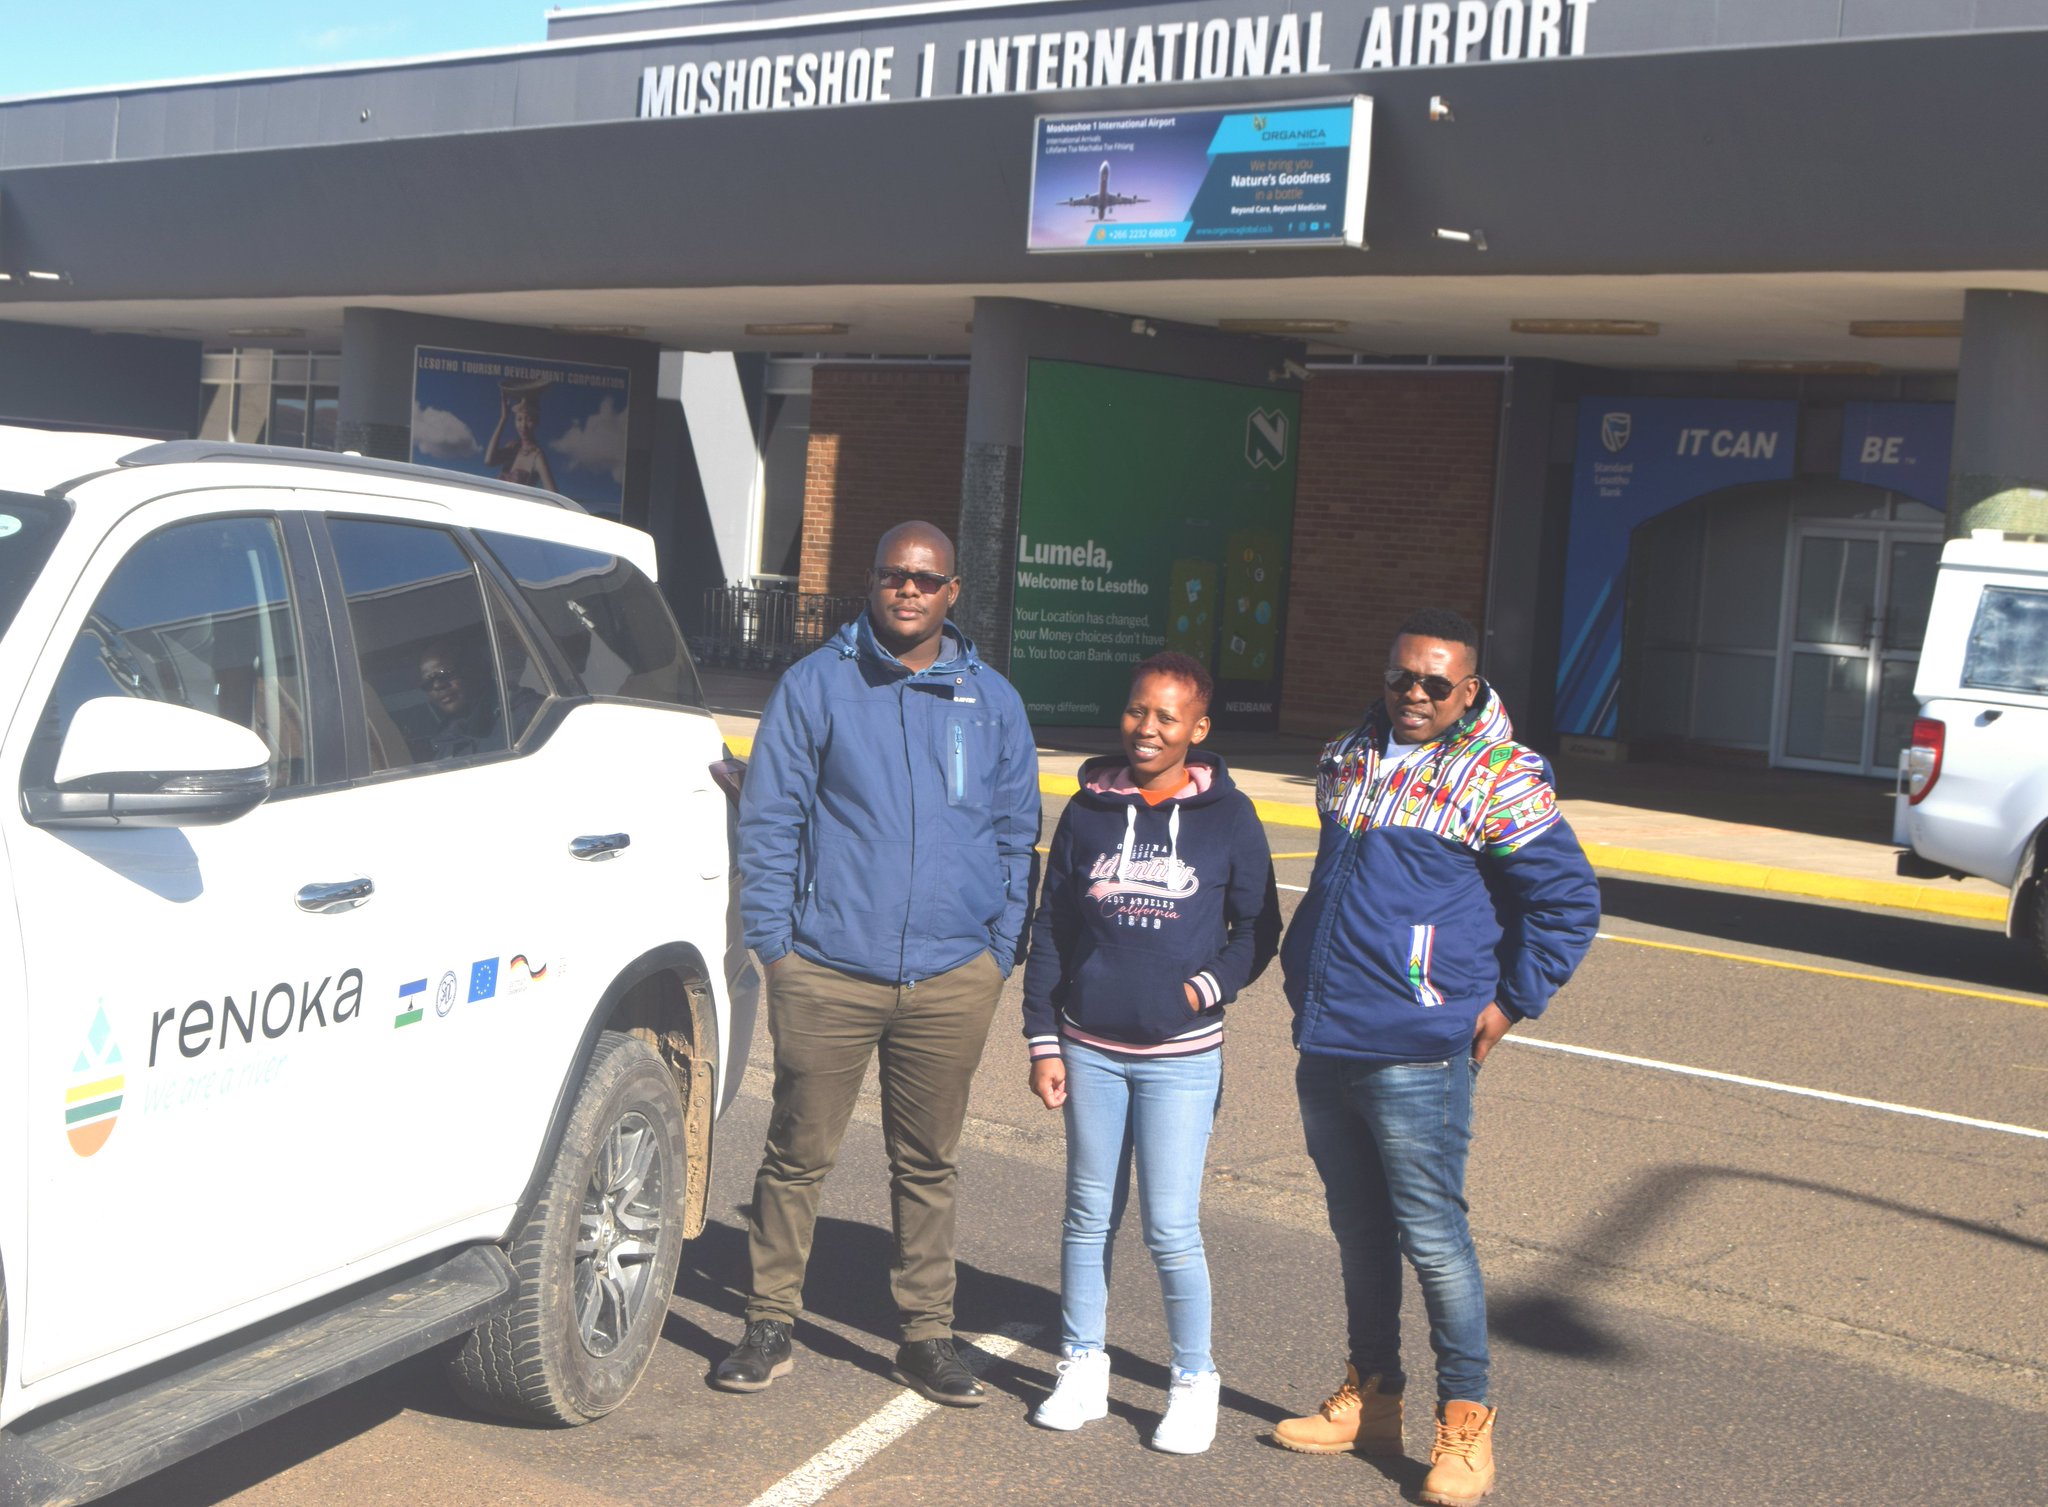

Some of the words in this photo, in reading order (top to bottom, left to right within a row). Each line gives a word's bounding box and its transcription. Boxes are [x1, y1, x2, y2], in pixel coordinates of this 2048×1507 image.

[640, 46, 894, 119] MOSHOESHOE
[920, 43, 935, 98] I
[961, 12, 1331, 96] INTERNATIONAL
[1360, 0, 1597, 70] AIRPORT
[1046, 122, 1091, 133] Moshoeshoe
[1098, 119, 1147, 130] International
[1148, 117, 1176, 129] Airport
[1262, 129, 1326, 141] ORGANICA
[1250, 160, 1265, 171] We
[1268, 159, 1293, 172] bring
[1296, 160, 1313, 171] you
[1231, 174, 1276, 187] Nature's
[1279, 172, 1331, 185] Goodness
[1255, 189, 1264, 200] in
[1266, 191, 1273, 200] a
[1275, 187, 1303, 200] bottle
[1231, 206, 1254, 215] Beyond
[1273, 204, 1296, 213] Beyond
[1297, 203, 1327, 212] Medicine
[418, 356, 458, 372] LESOTHO
[462, 361, 500, 377] TOURISM
[504, 366, 564, 383] DEVELOPMENT
[568, 372, 625, 389] CORPORATION
[1677, 428, 1709, 456] IT
[1711, 429, 1777, 459] CAN
[1860, 436, 1904, 464] BE
[1594, 462, 1633, 473] Standard
[1019, 534, 1113, 574] Lumela,
[1017, 571, 1079, 591] Welcome
[1081, 576, 1095, 592] to
[1097, 576, 1149, 595] Lesotho
[1015, 607, 1039, 621] Your
[1040, 608, 1085, 623] Location
[1086, 611, 1104, 625] has
[1105, 612, 1150, 628] changed,
[1014, 629, 1037, 642] your
[1039, 627, 1073, 644] Money
[1075, 629, 1113, 644] choices
[1115, 631, 1141, 645] don't
[1142, 633, 1165, 646] have
[1013, 646, 1026, 659] to.
[1028, 646, 1047, 660] You
[1049, 648, 1066, 660] too
[1068, 650, 1086, 661] can
[1088, 648, 1113, 662] Bank
[1115, 651, 1127, 662] on
[1129, 652, 1141, 663] us.
[1027, 703, 1057, 714] money
[1057, 702, 1100, 715] differently
[1225, 701, 1273, 713] NEDBANK
[1101, 896, 1181, 920] California
[1130, 897, 1175, 909] ANGELES
